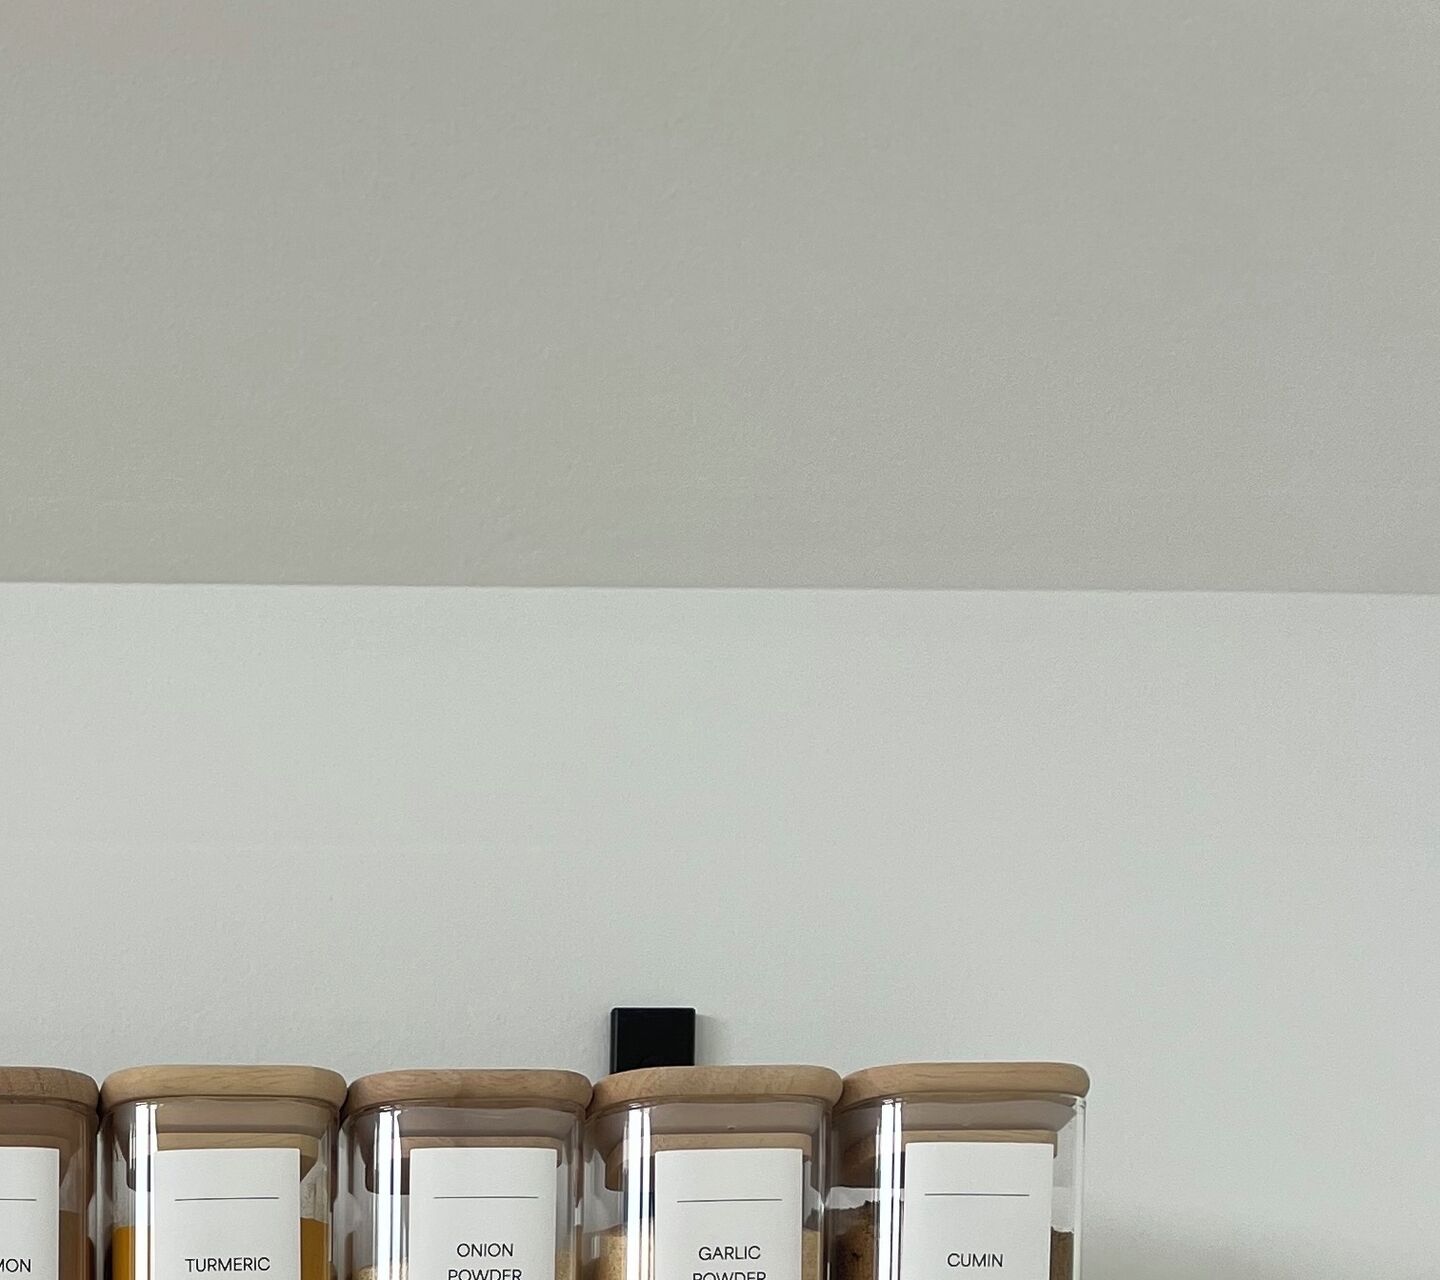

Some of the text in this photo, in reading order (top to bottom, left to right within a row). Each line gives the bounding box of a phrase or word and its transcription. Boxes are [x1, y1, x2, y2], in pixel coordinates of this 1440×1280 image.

[456, 1242, 514, 1258] ONION
[698, 1245, 762, 1261] GARLIC
[184, 1256, 271, 1273] TURMERIC
[947, 1252, 1004, 1268] CUMIN
